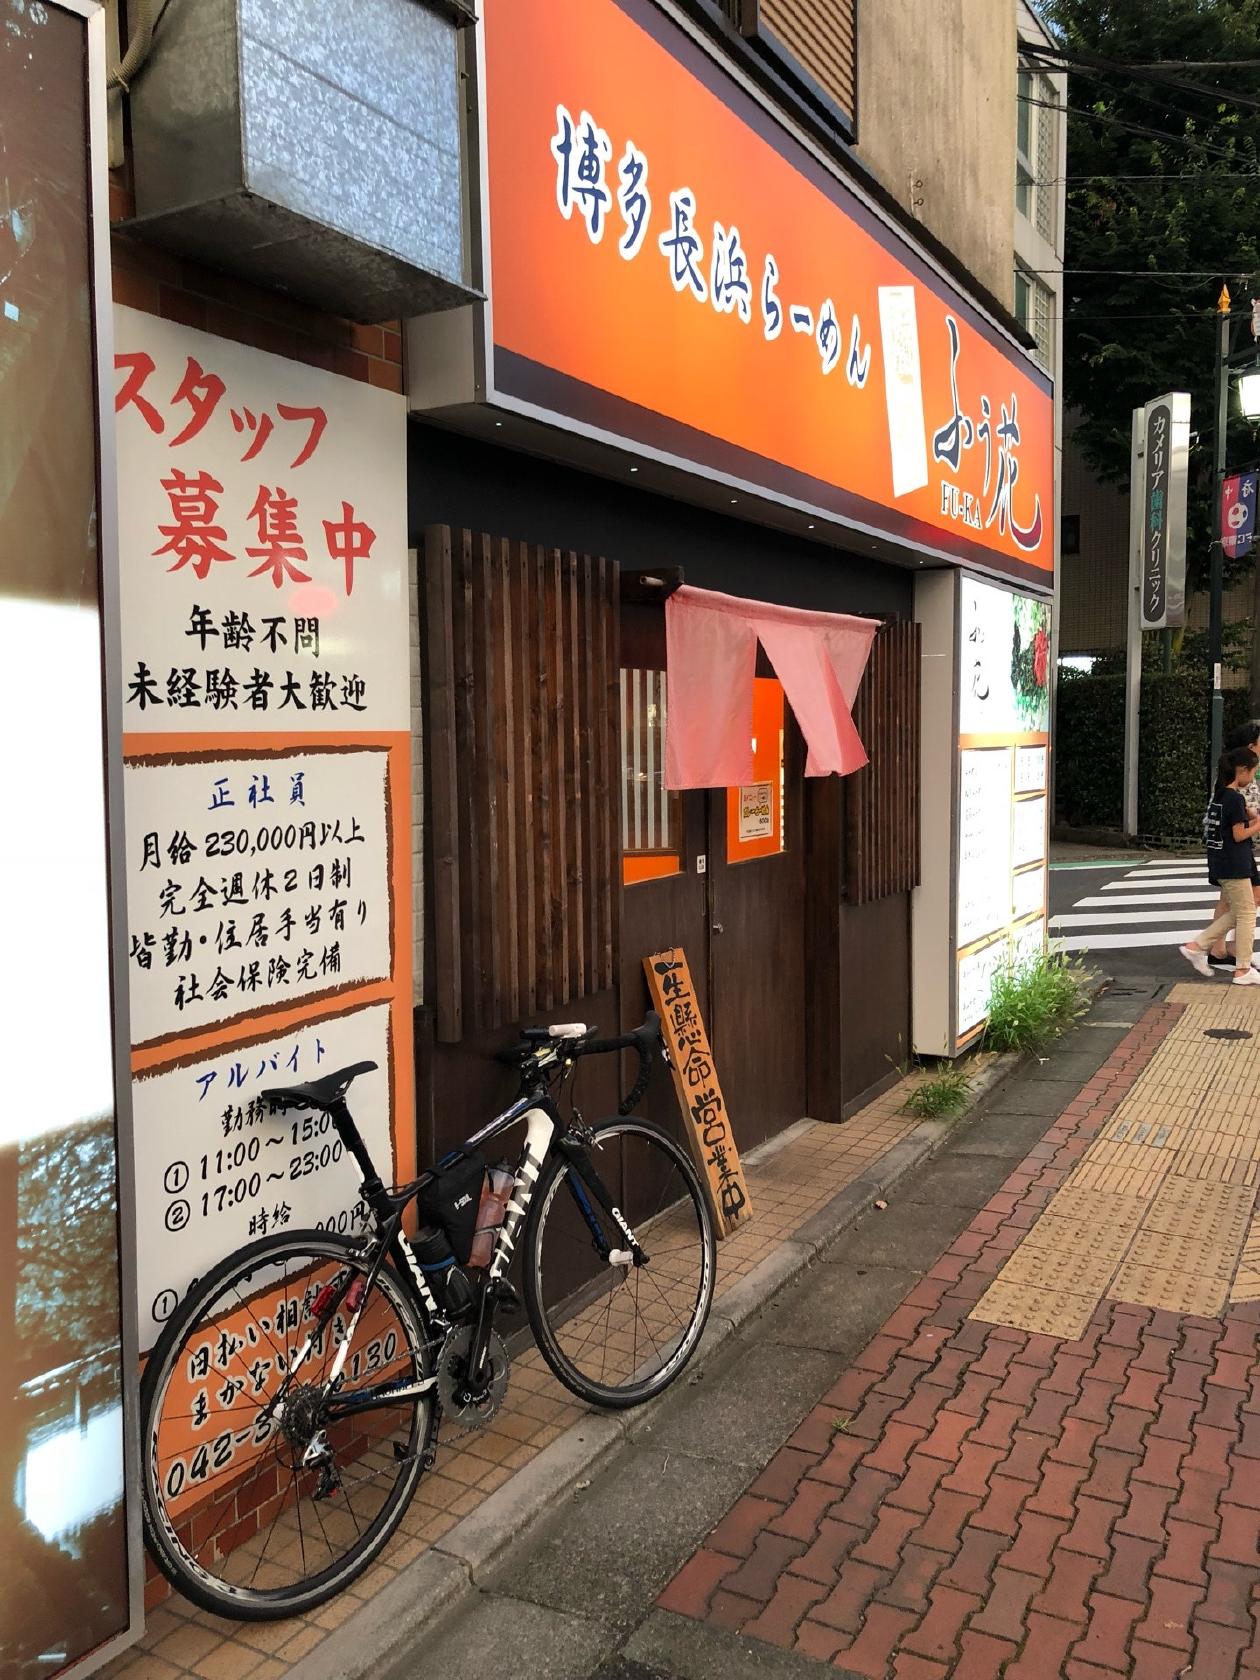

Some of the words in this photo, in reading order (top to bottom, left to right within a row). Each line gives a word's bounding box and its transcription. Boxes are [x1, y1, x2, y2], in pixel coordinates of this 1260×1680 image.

[551, 104, 872, 390] 博多長浜らーめん
[114, 351, 328, 469] スタッフ
[150, 467, 377, 596] 募集中
[1150, 416, 1166, 613] カメリア歯科クリニック
[184, 603, 320, 658] 年齢不問
[126, 661, 368, 711] 未経験者大歓迎
[207, 772, 305, 810] 正社員
[139, 816, 365, 871] 月給230,000円以上
[158, 857, 351, 919] 完全週休2日制
[129, 899, 367, 970] 皆勤・住居手当有り
[173, 940, 341, 1011] 社会保険完備
[195, 1038, 326, 1101] アルバイト
[248, 1201, 292, 1236] 時給
[611, 1207, 640, 1247] GIANT
